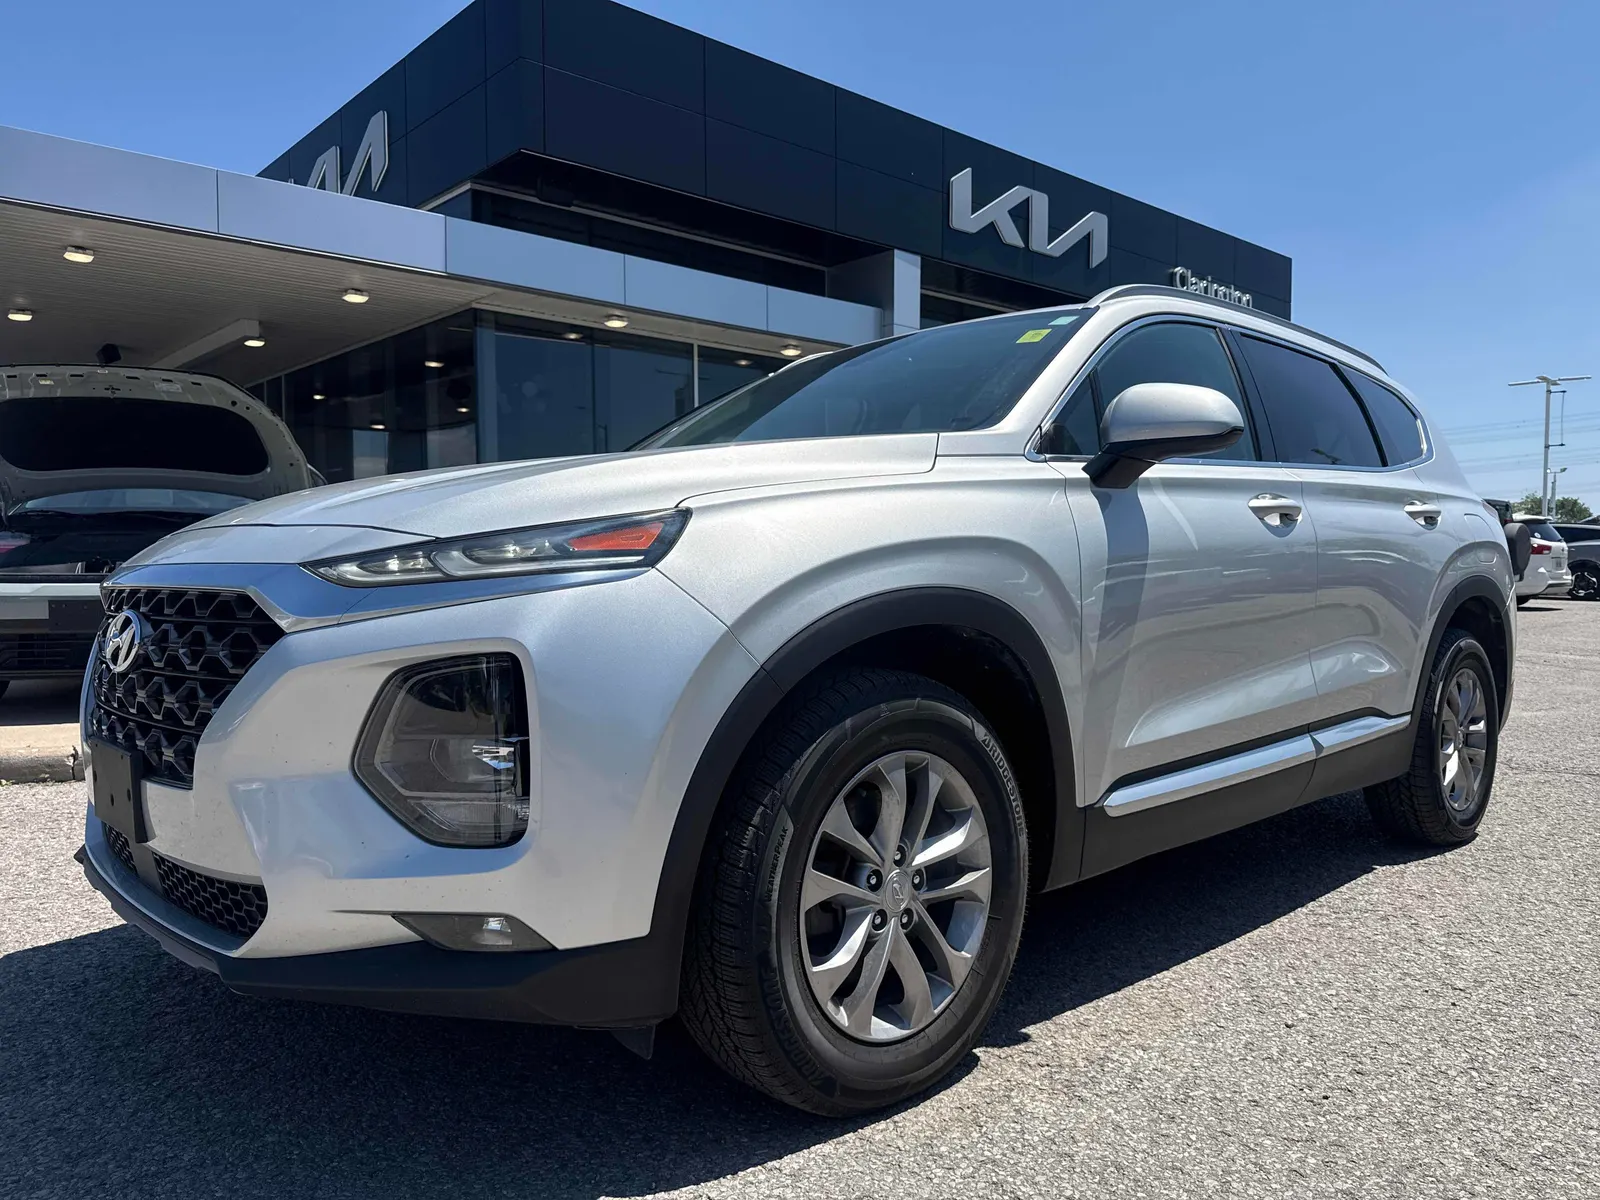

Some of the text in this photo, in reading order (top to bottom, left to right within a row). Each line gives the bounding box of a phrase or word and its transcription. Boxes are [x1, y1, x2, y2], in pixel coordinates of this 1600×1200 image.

[287, 110, 389, 197] IA
[949, 167, 1108, 269] KIA
[981, 732, 1025, 838] BRIDGESTONE
